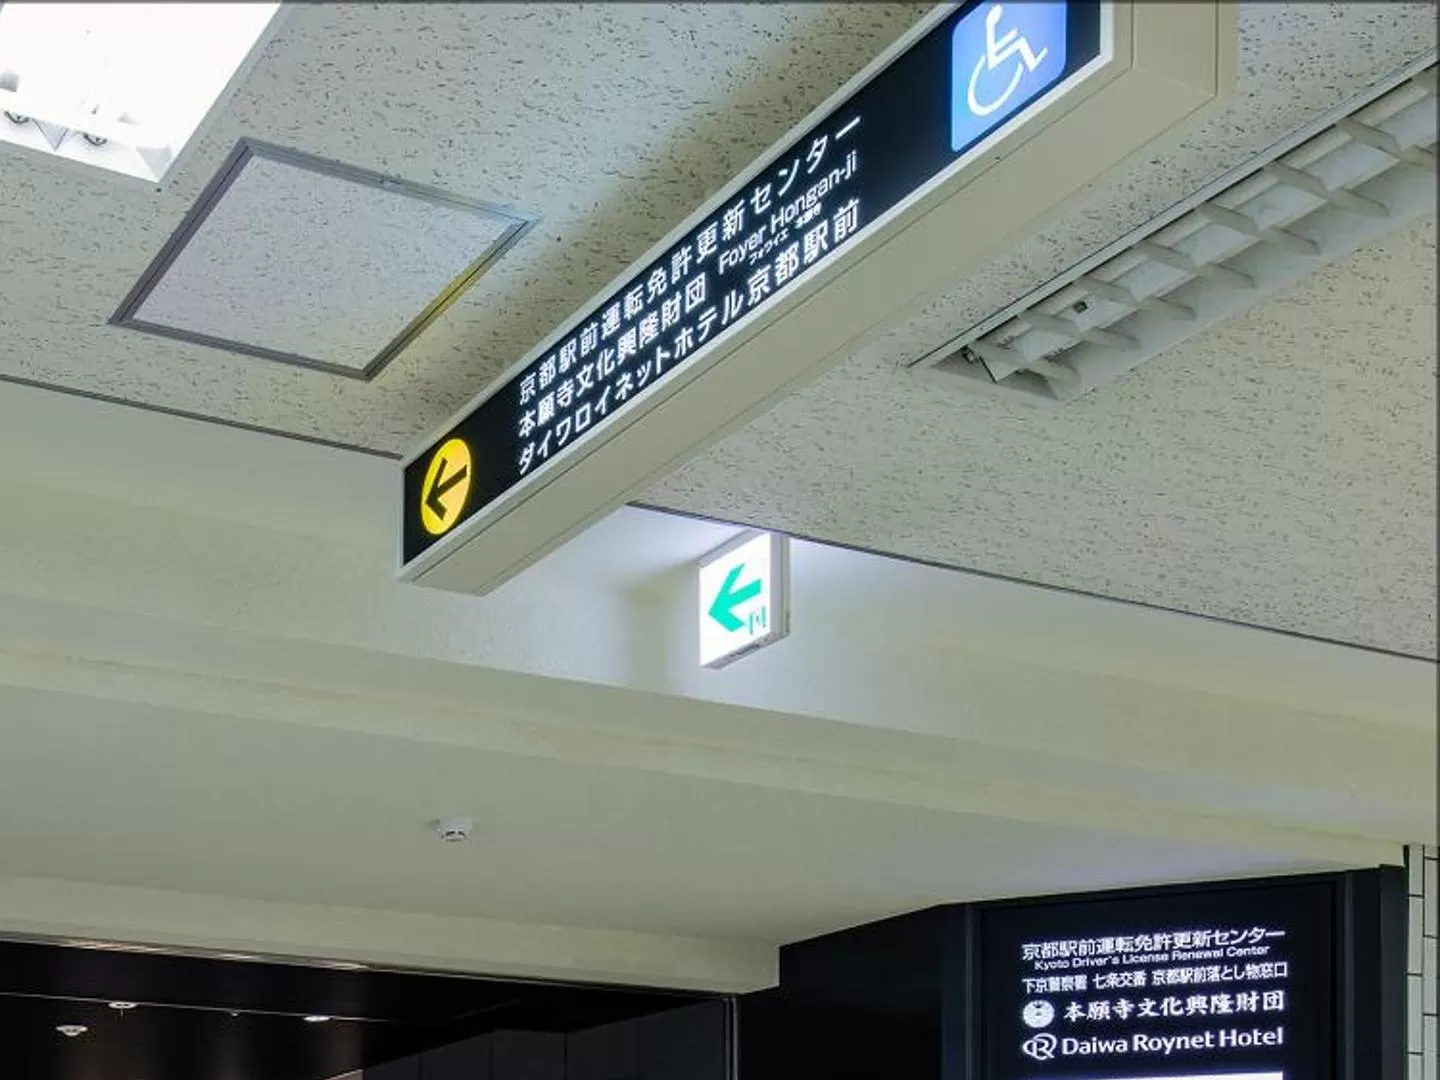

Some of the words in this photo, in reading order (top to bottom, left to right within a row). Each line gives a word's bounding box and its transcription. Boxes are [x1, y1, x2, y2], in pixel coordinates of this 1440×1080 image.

[520, 114, 860, 405] 京都駅前運転免許更新センター
[519, 272, 706, 437] 本願寺文化興隆財団
[718, 224, 767, 275] Foyer
[771, 150, 857, 235] Hongan-ji
[519, 198, 859, 475] ダイワロイネットホテル京都駅前
[1022, 927, 1285, 961] 京都駅前運転免許更新センター
[1034, 958, 1069, 970] Kyoto
[1123, 952, 1168, 965] License
[1172, 948, 1223, 961] Renewal
[1226, 945, 1270, 957] Center
[1064, 990, 1284, 1022] 本願寺文化興隆財団
[1062, 1037, 1128, 1055] Daiwa
[1133, 1030, 1214, 1055] Roynet
[1220, 1027, 1283, 1047] Hotel
